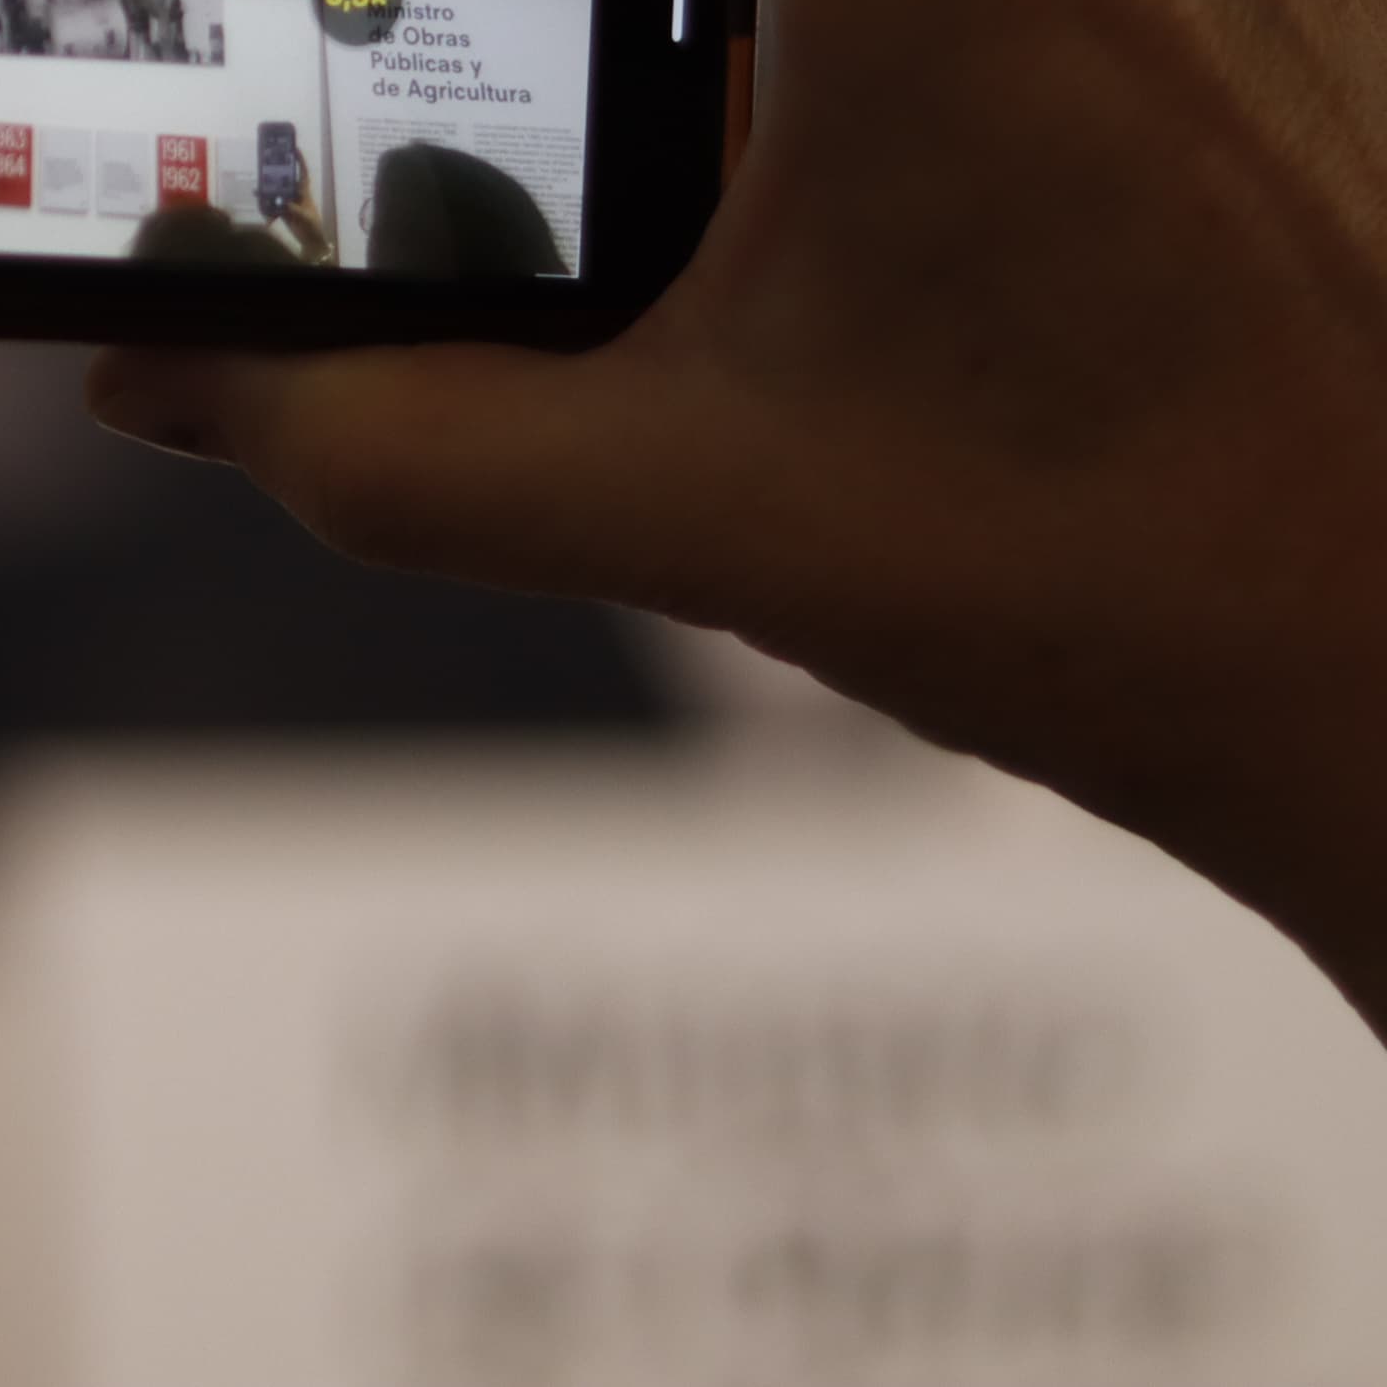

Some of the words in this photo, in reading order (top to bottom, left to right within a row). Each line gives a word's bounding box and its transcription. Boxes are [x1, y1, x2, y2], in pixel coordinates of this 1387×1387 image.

[368, 24, 395, 44] de
[403, 26, 471, 48] Obras
[370, 51, 463, 74] Públicas
[470, 60, 482, 79] y
[372, 77, 400, 97] de
[407, 79, 532, 104] Agricultura
[162, 137, 196, 161] 1961
[162, 165, 201, 191] 1962
